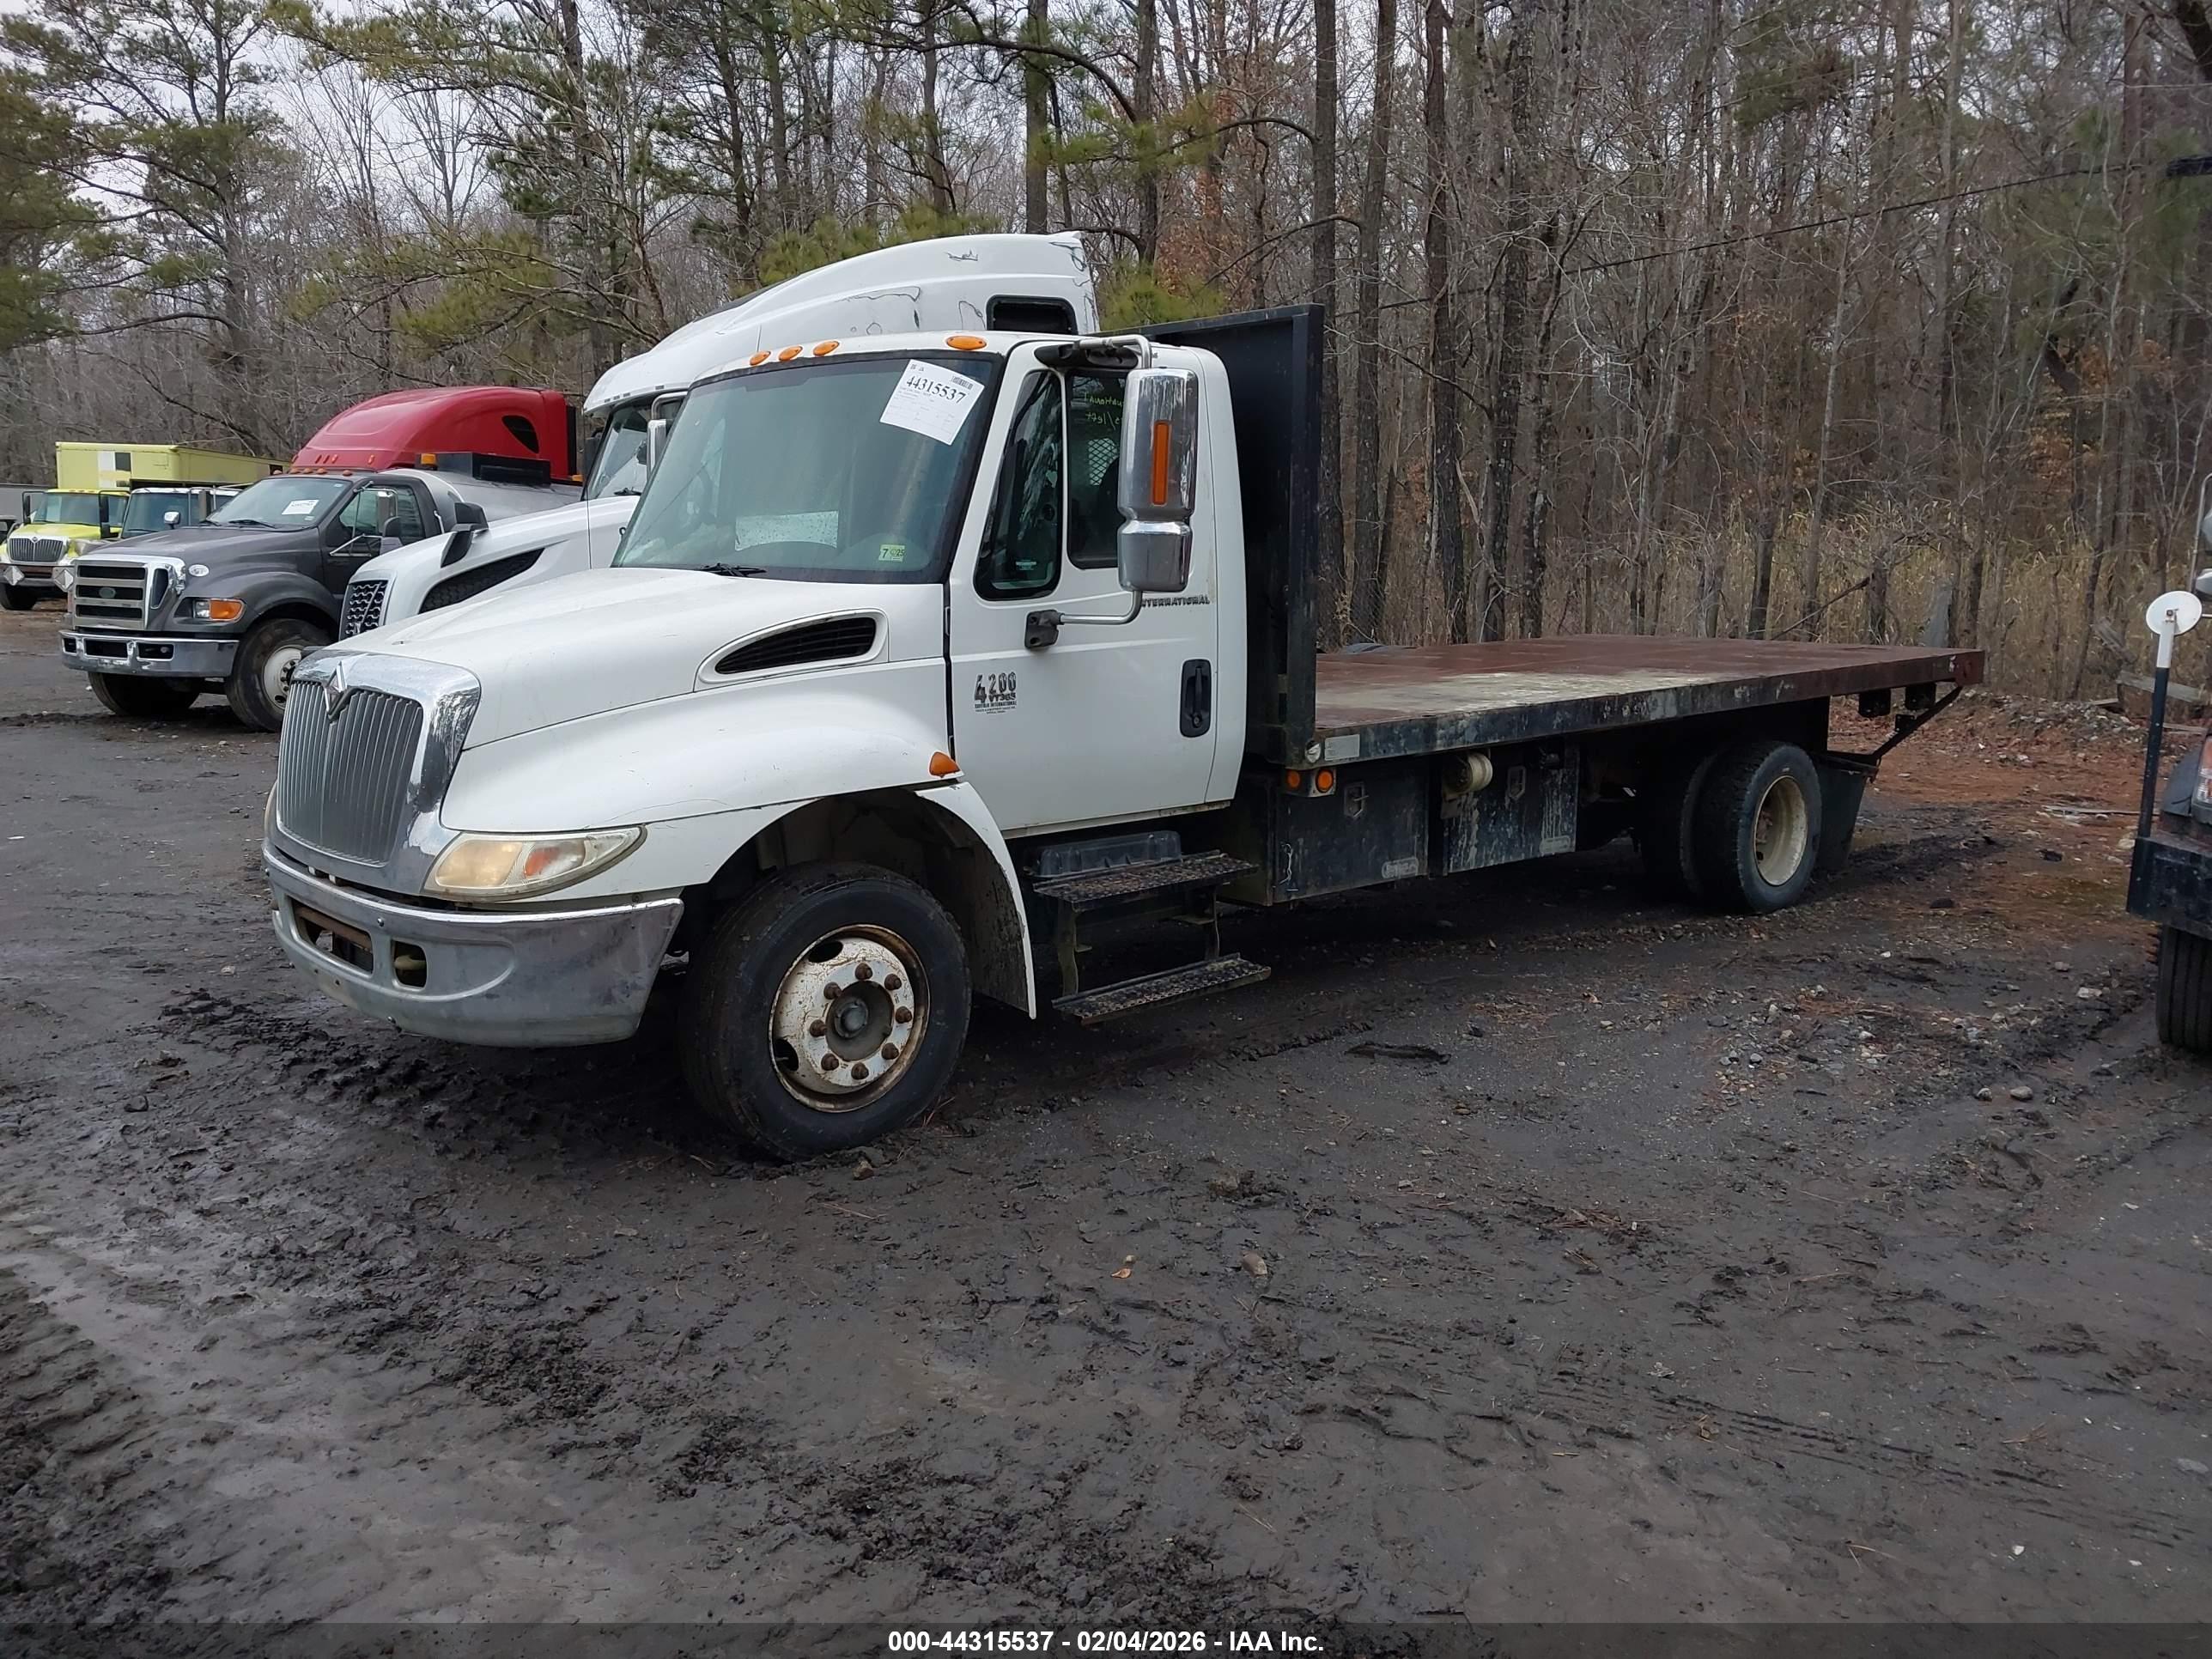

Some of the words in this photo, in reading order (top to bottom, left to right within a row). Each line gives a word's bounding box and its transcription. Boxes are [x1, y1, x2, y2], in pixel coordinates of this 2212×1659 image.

[906, 375, 967, 404] 44315537
[882, 548, 889, 558] 7
[975, 672, 1017, 703] 4200
